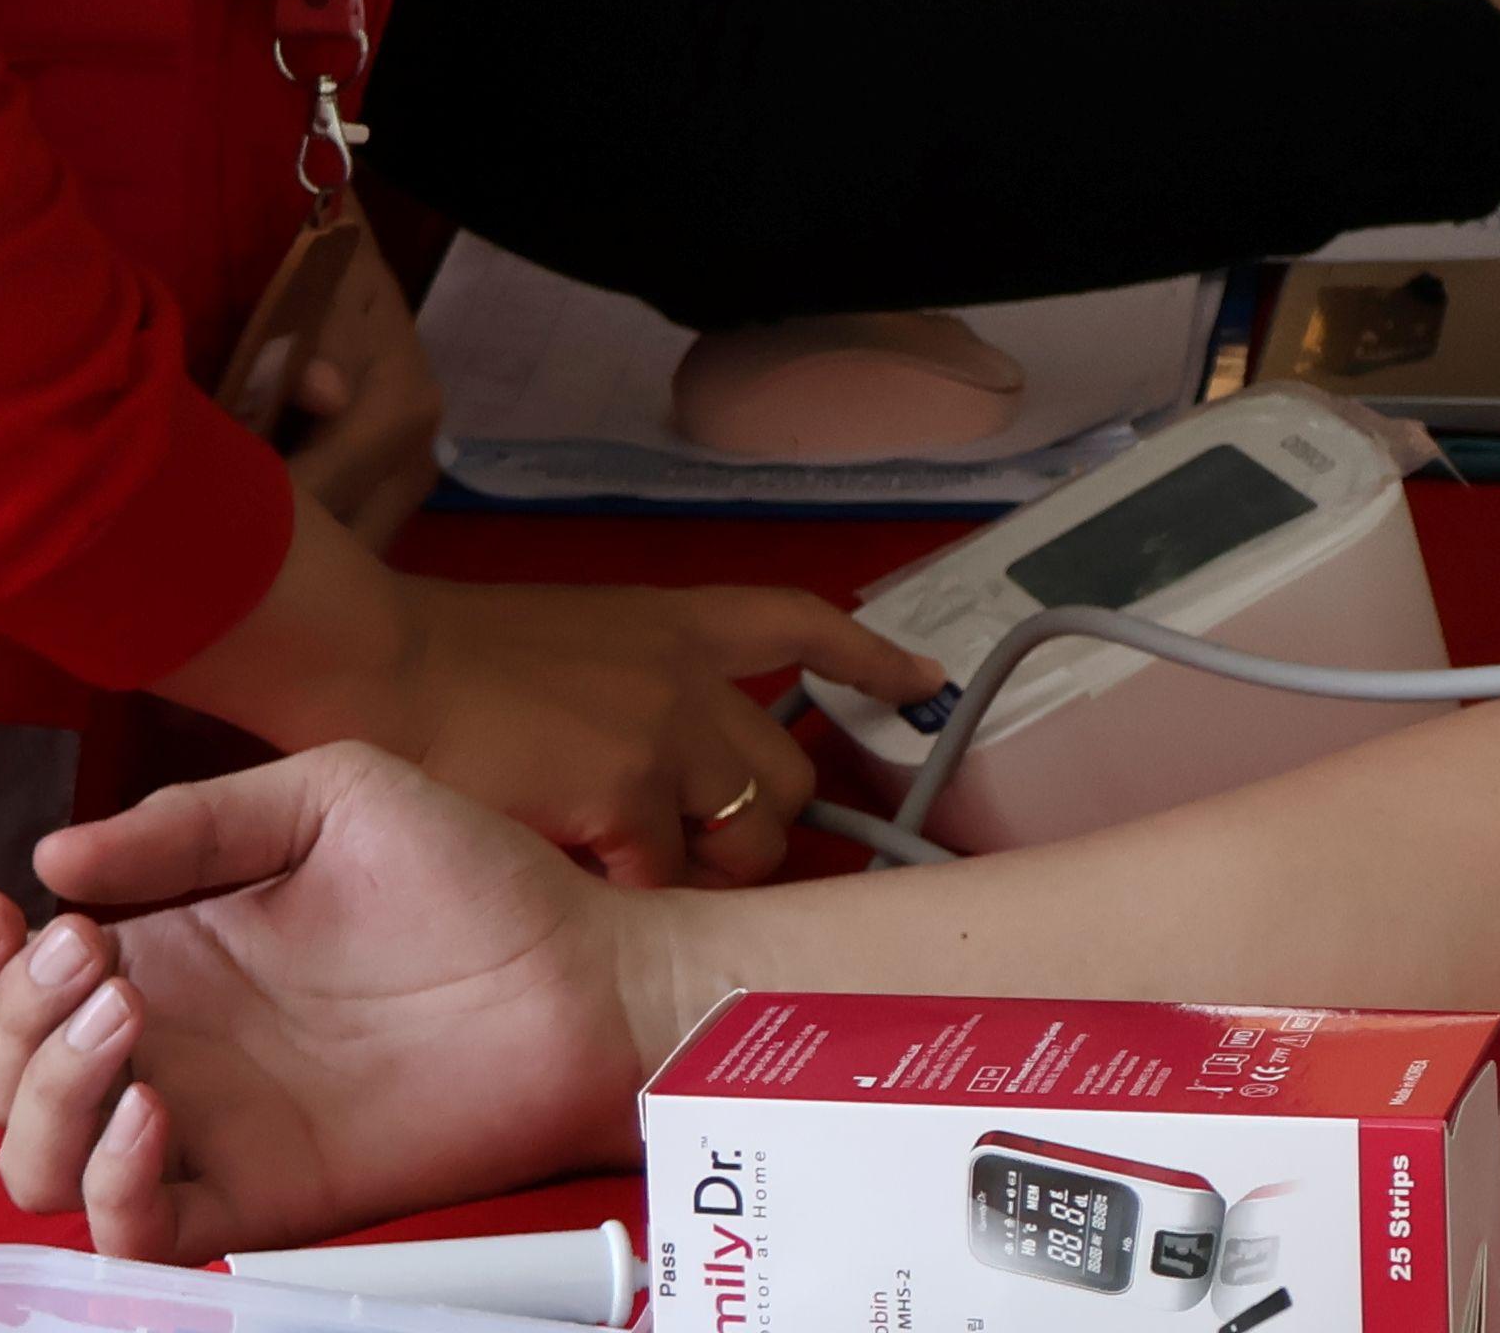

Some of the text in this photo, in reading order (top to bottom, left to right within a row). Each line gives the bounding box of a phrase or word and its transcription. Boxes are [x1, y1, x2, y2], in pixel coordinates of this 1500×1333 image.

[752, 1149, 768, 1219] Home
[1026, 1184, 1040, 1211] MEM
[756, 1233, 769, 1259] at
[1122, 1236, 1133, 1252] Hb
[1388, 1154, 1416, 1282] 25 Strips
[659, 1241, 677, 1298] Pass
[896, 1268, 912, 1331] MHS-2
